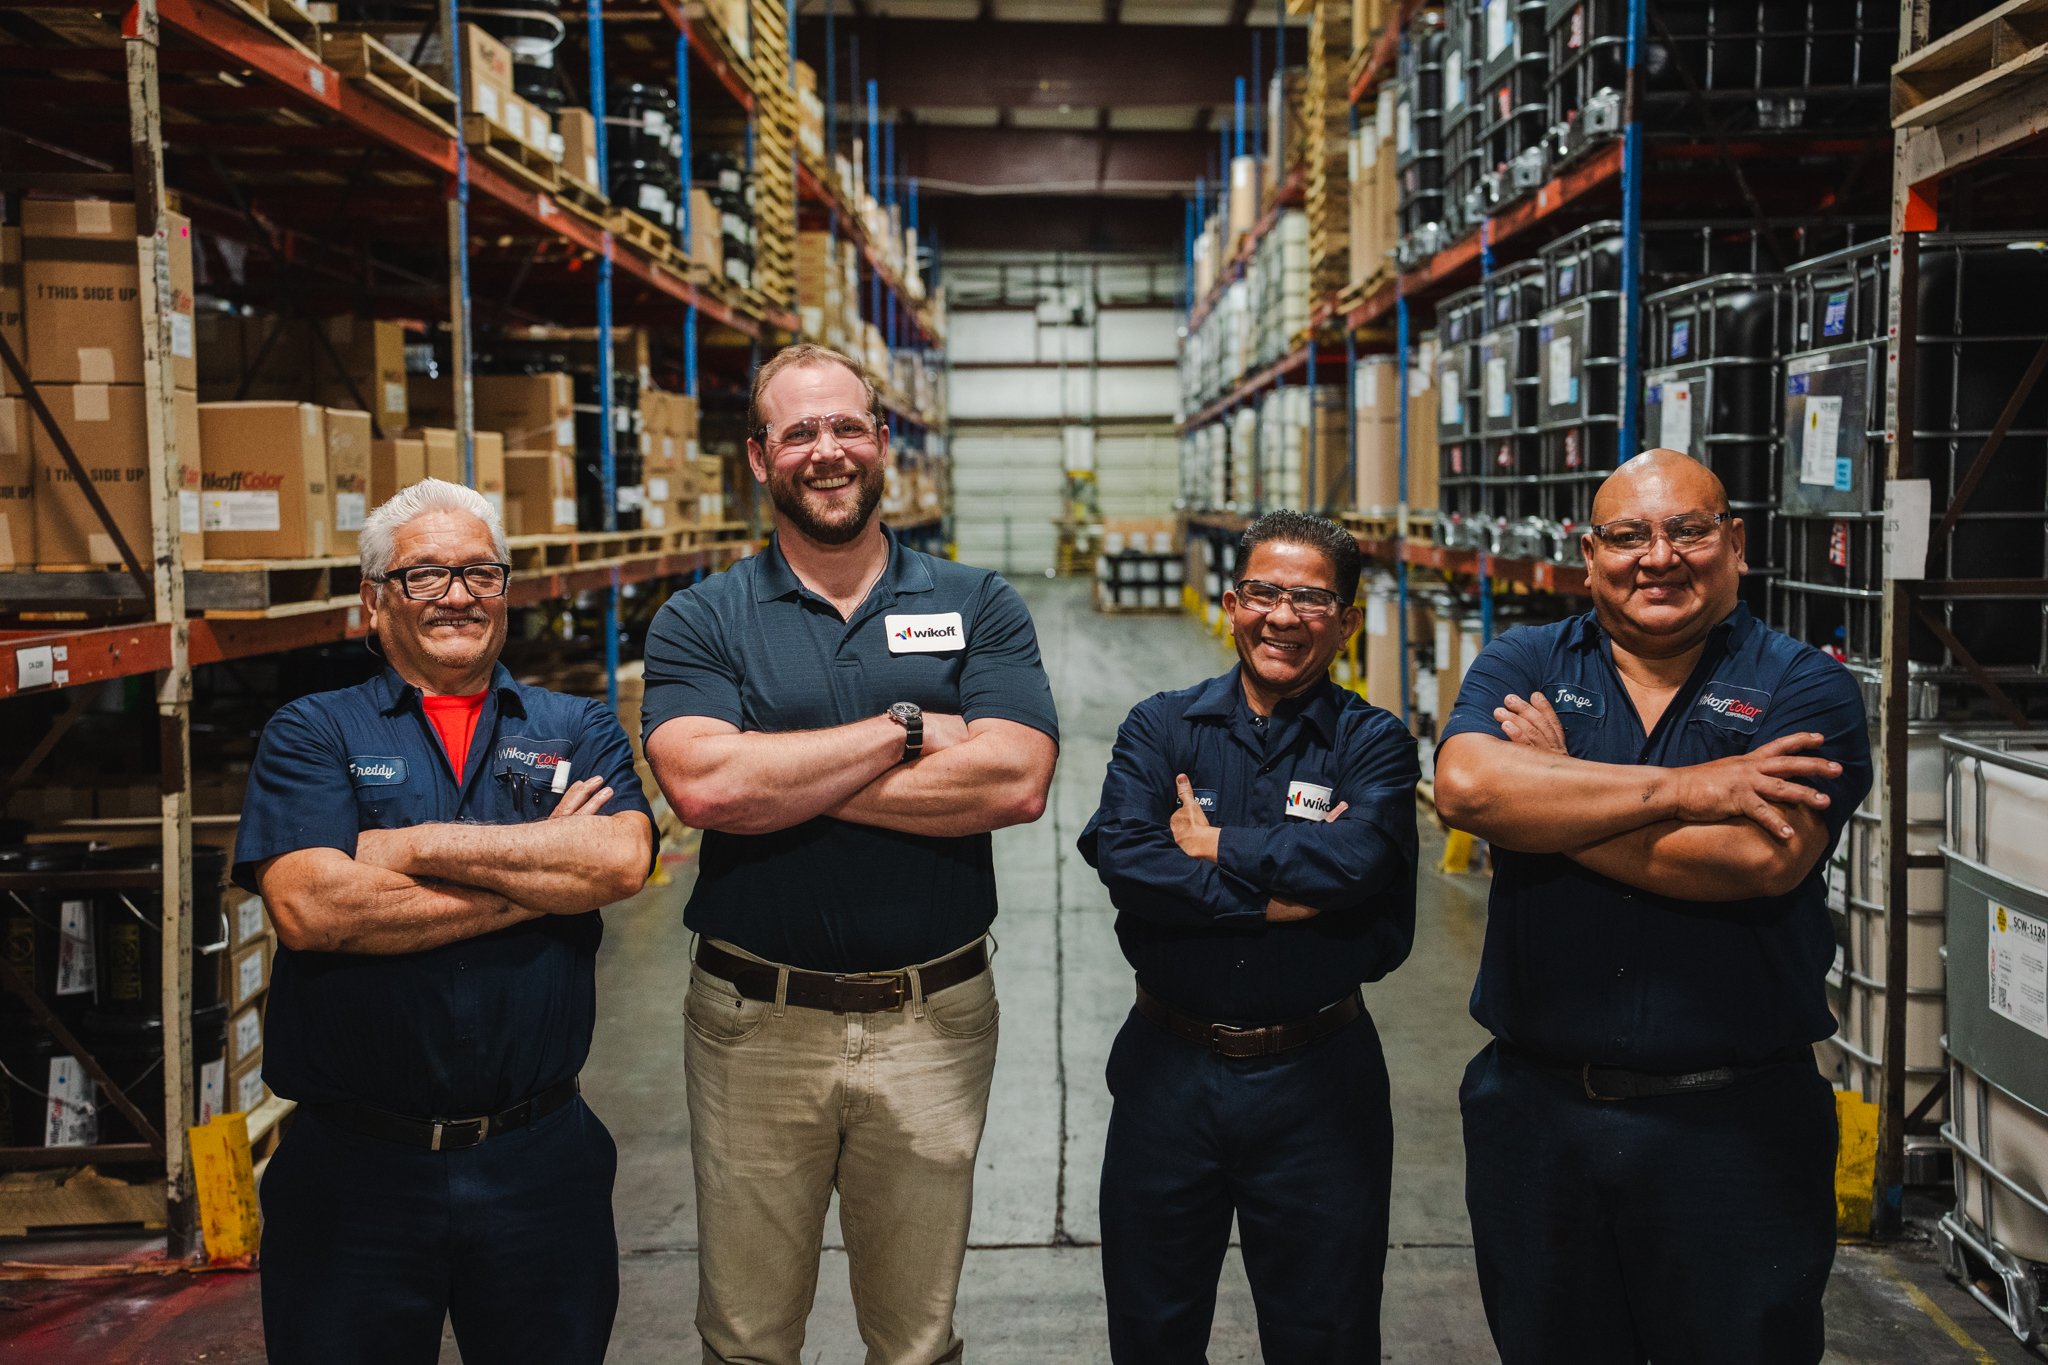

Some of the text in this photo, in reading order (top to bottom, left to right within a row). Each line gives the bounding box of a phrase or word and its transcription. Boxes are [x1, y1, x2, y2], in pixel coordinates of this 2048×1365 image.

[47, 286, 137, 302] THIS SIDE UP
[91, 468, 121, 482] SIDE
[126, 468, 145, 482] UP
[914, 626, 956, 638] wikoff
[1303, 796, 1331, 813] wiko
[2013, 916, 2046, 940] SCW-1124
